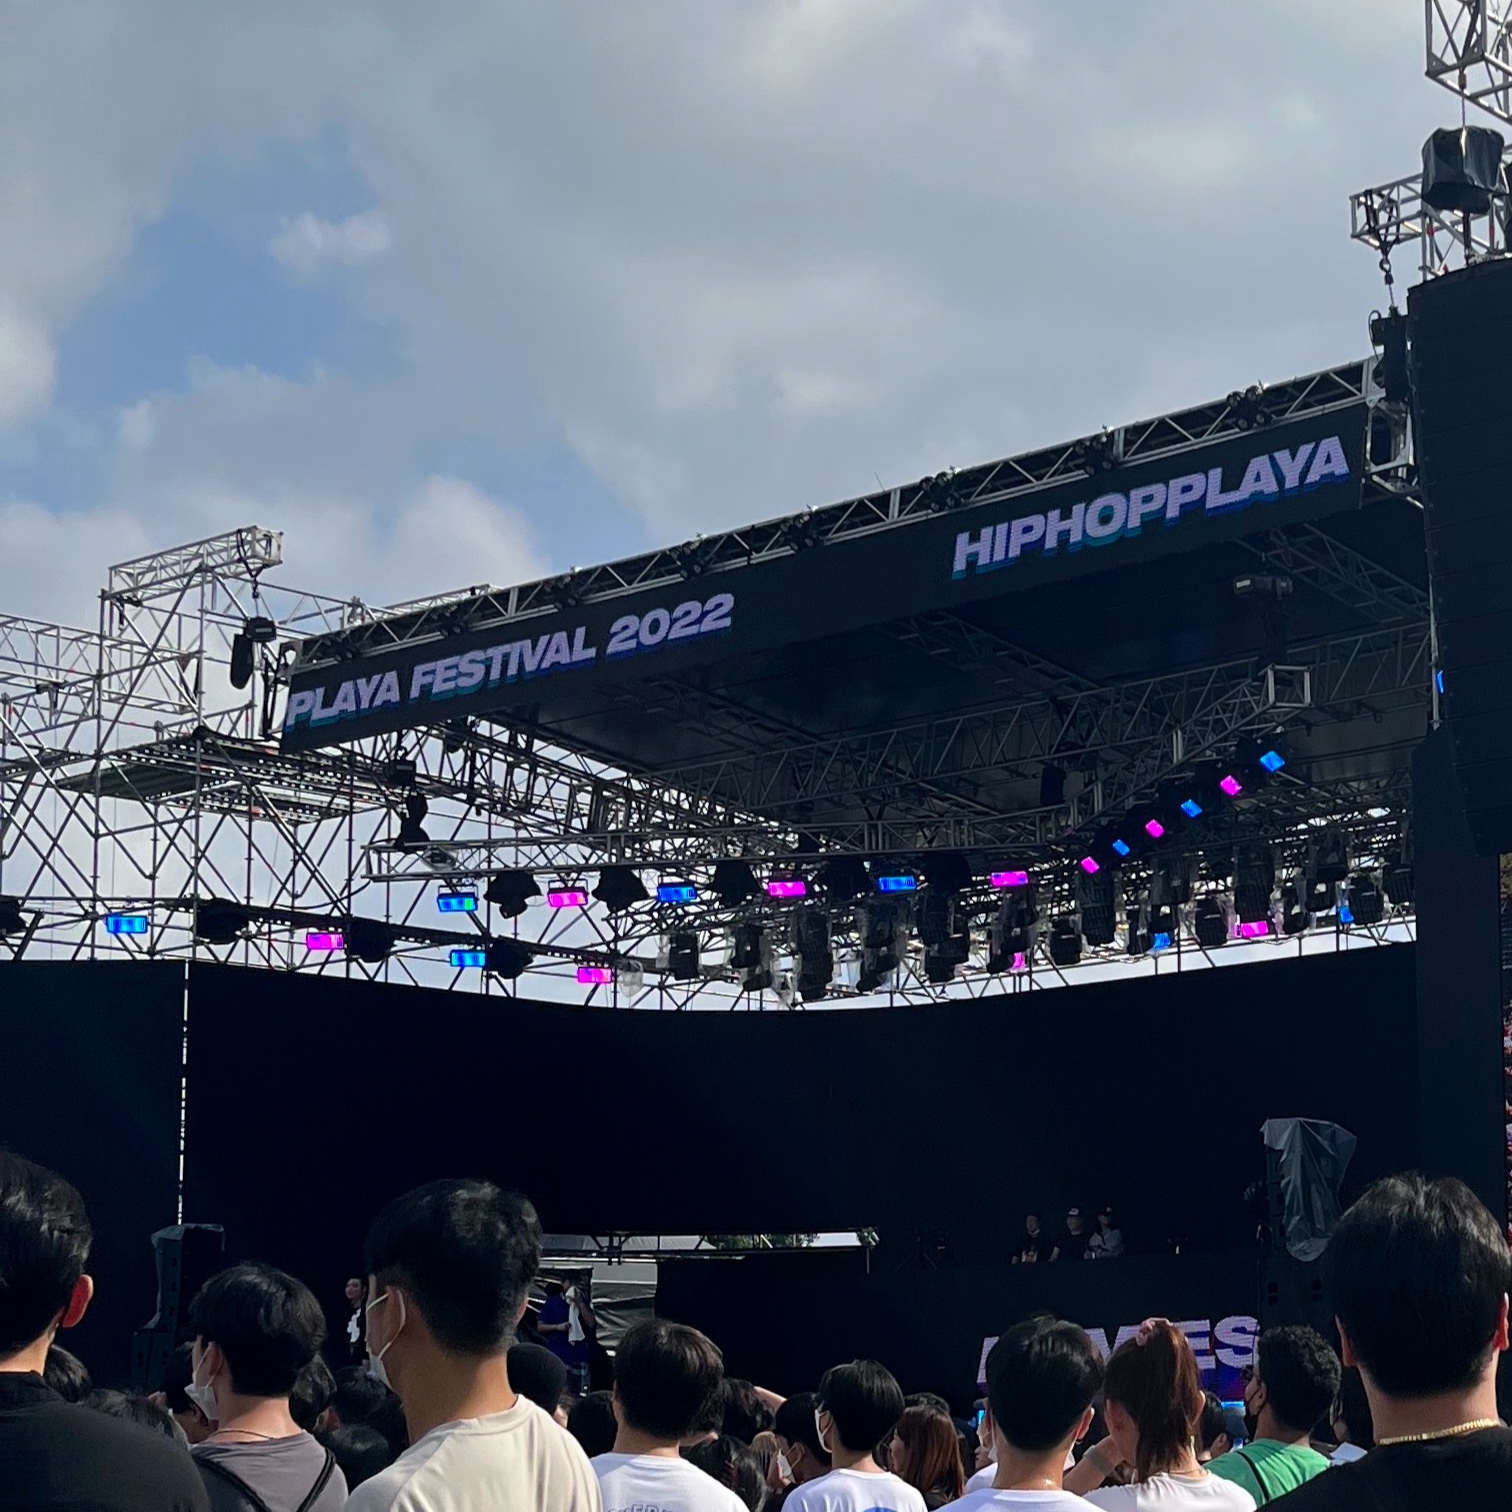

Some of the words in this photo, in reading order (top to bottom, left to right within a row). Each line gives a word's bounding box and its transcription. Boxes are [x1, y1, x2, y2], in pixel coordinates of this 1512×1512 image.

[952, 435, 1351, 577] HIPHOPPLAYA
[284, 670, 401, 732] PLAYA
[408, 626, 597, 703] FESTIVAL
[606, 592, 735, 662] 2022
